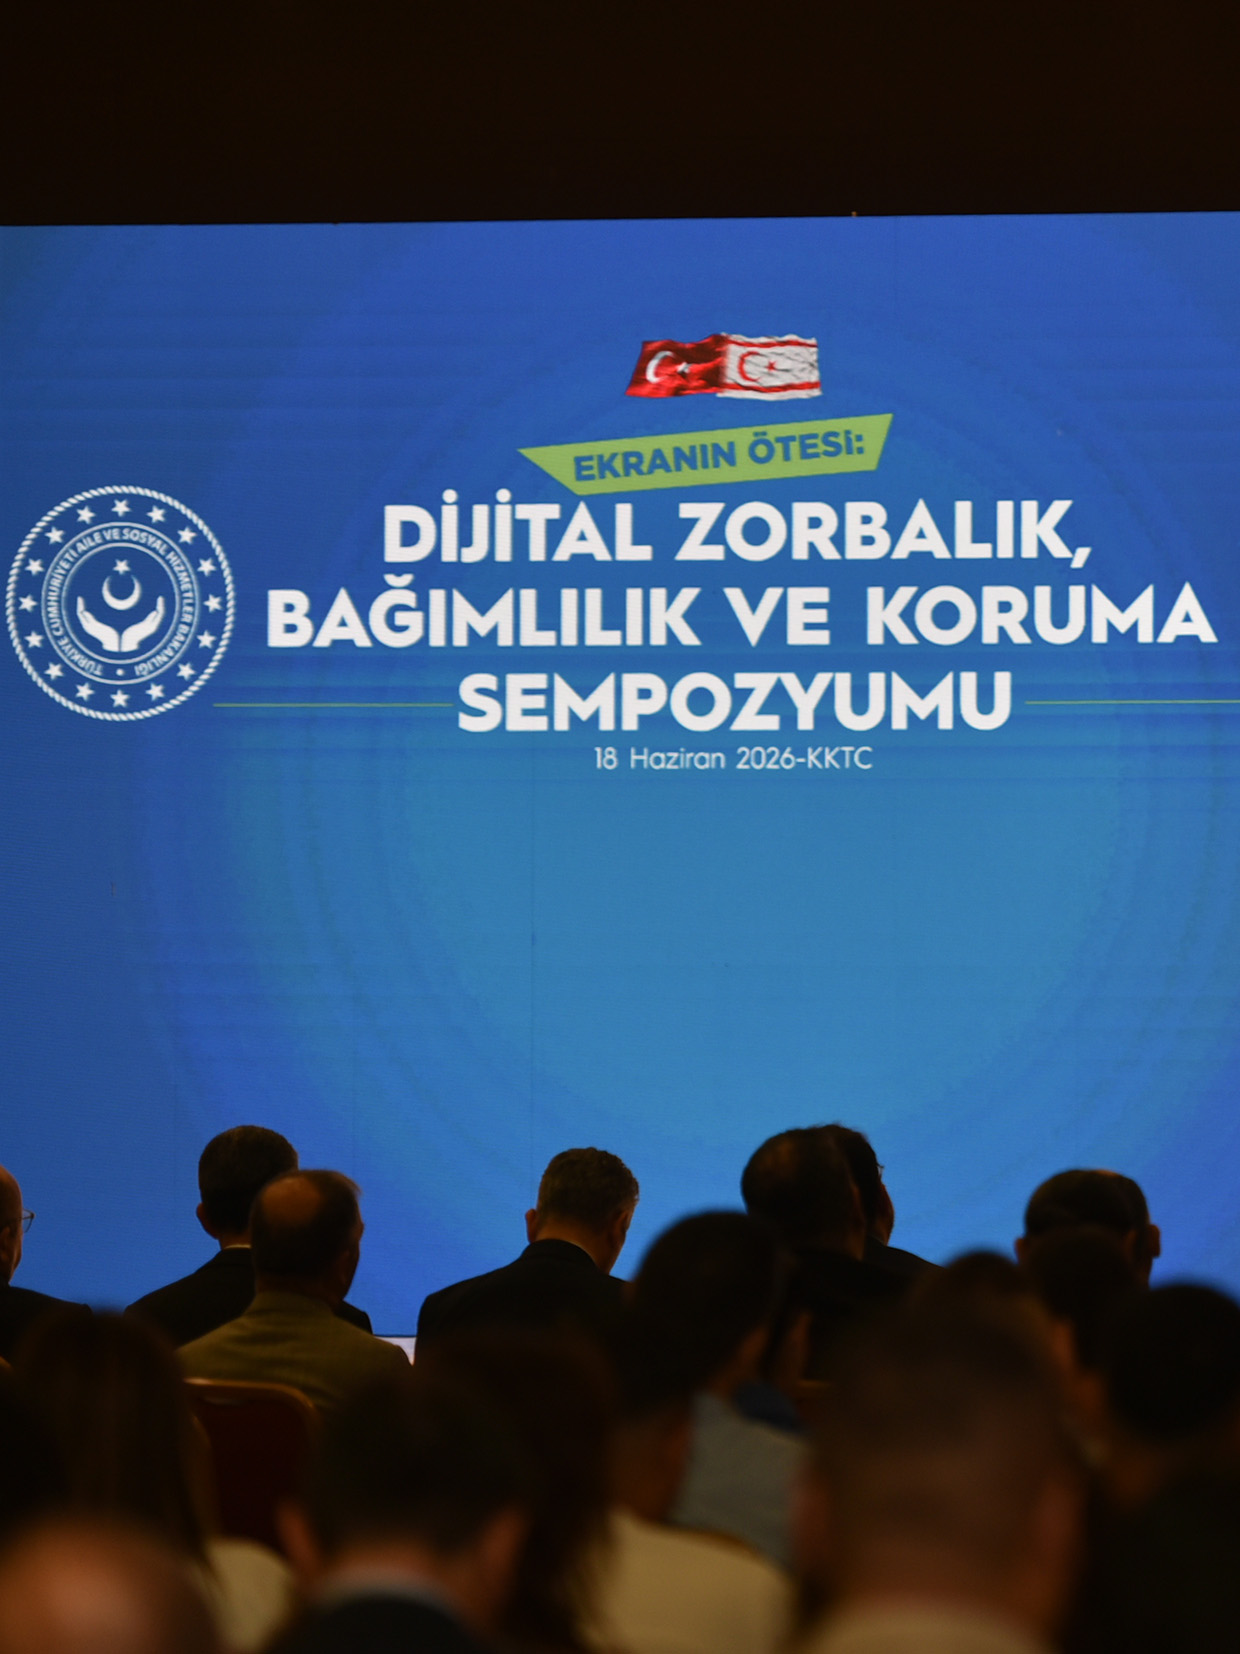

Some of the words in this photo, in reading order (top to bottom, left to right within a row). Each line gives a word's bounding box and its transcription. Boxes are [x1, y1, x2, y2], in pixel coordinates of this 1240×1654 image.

[573, 441, 737, 482] EKRANIN
[748, 429, 865, 464] ÖTESİ:
[102, 528, 120, 541] VE
[121, 528, 171, 555] SOSYAL
[383, 488, 654, 563] DİJİTAL
[674, 498, 1092, 569] ZORBALIK,
[267, 573, 701, 648] BAĞIMLILIK
[723, 586, 831, 647] VE
[866, 581, 1218, 646] KORUMA
[457, 671, 1013, 732] SEMPOZYUMU
[595, 746, 619, 770] 18
[630, 747, 726, 770] Haziran
[736, 746, 873, 770] 2026-KKTC
